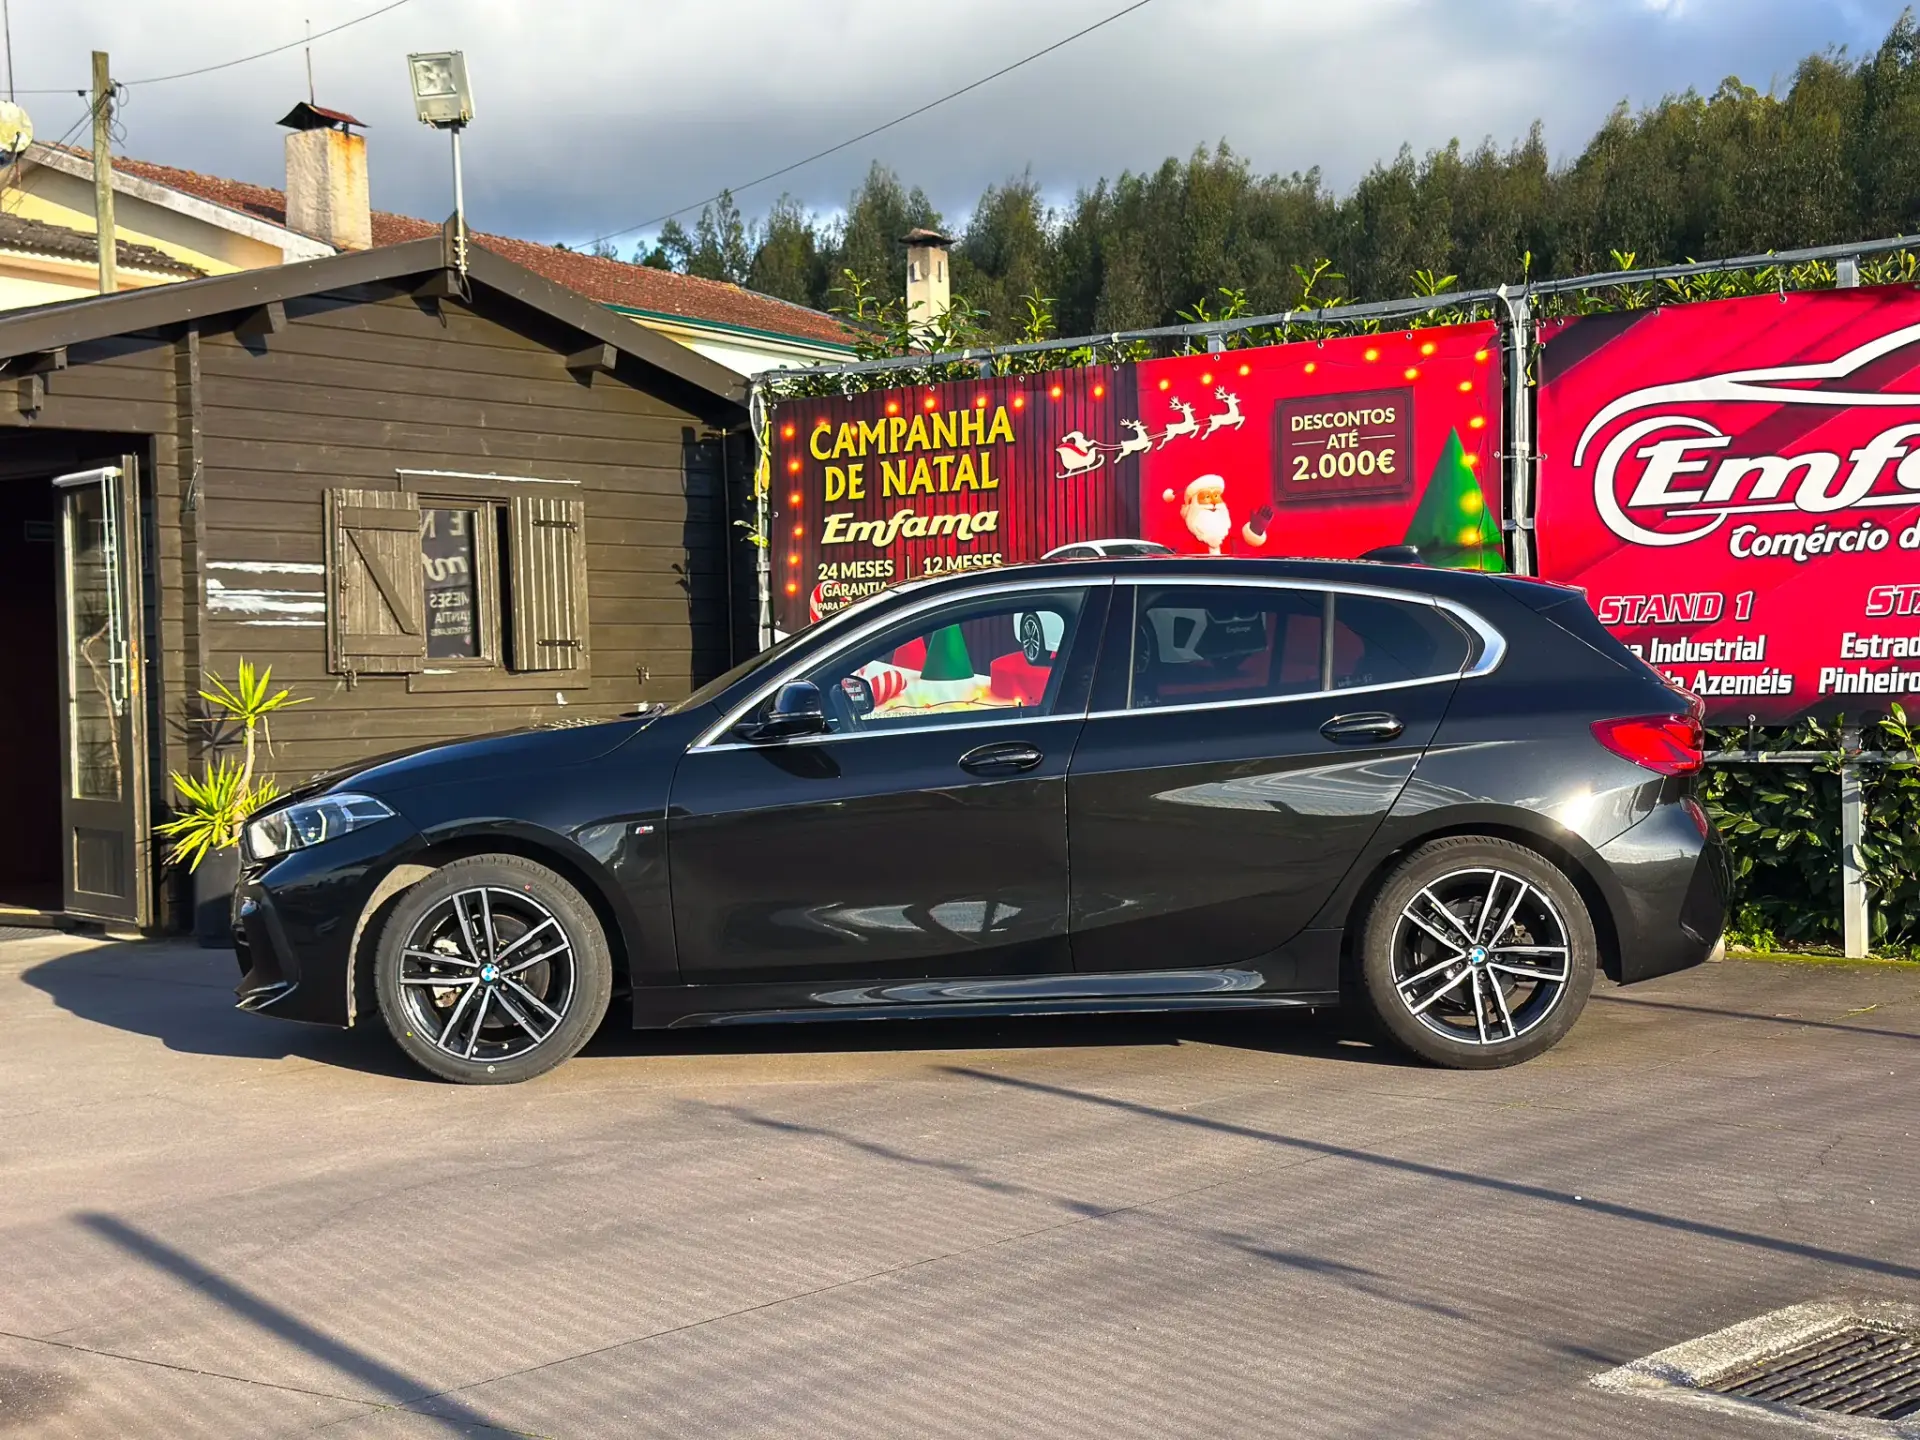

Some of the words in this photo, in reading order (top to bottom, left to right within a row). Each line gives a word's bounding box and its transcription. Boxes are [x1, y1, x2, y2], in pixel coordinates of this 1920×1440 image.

[810, 405, 1015, 460] CAMPANHA
[1291, 407, 1396, 432] DESCONTOS
[1326, 428, 1359, 449] ATÉ
[825, 463, 865, 501] DE
[880, 452, 999, 497] NATAL
[1292, 448, 1396, 481] 2.000€
[820, 509, 999, 547] Emfama
[1729, 522, 1889, 562] Comércio
[818, 563, 838, 580] 24
[841, 560, 894, 579] MESES
[923, 556, 943, 575] 12
[818, 602, 839, 611] PARA
[1598, 592, 1724, 624] STAND
[1735, 590, 1754, 620] 1
[1650, 635, 1765, 663] Industrial
[1840, 630, 1920, 659] Estrad
[1691, 667, 1793, 695] Azeméis
